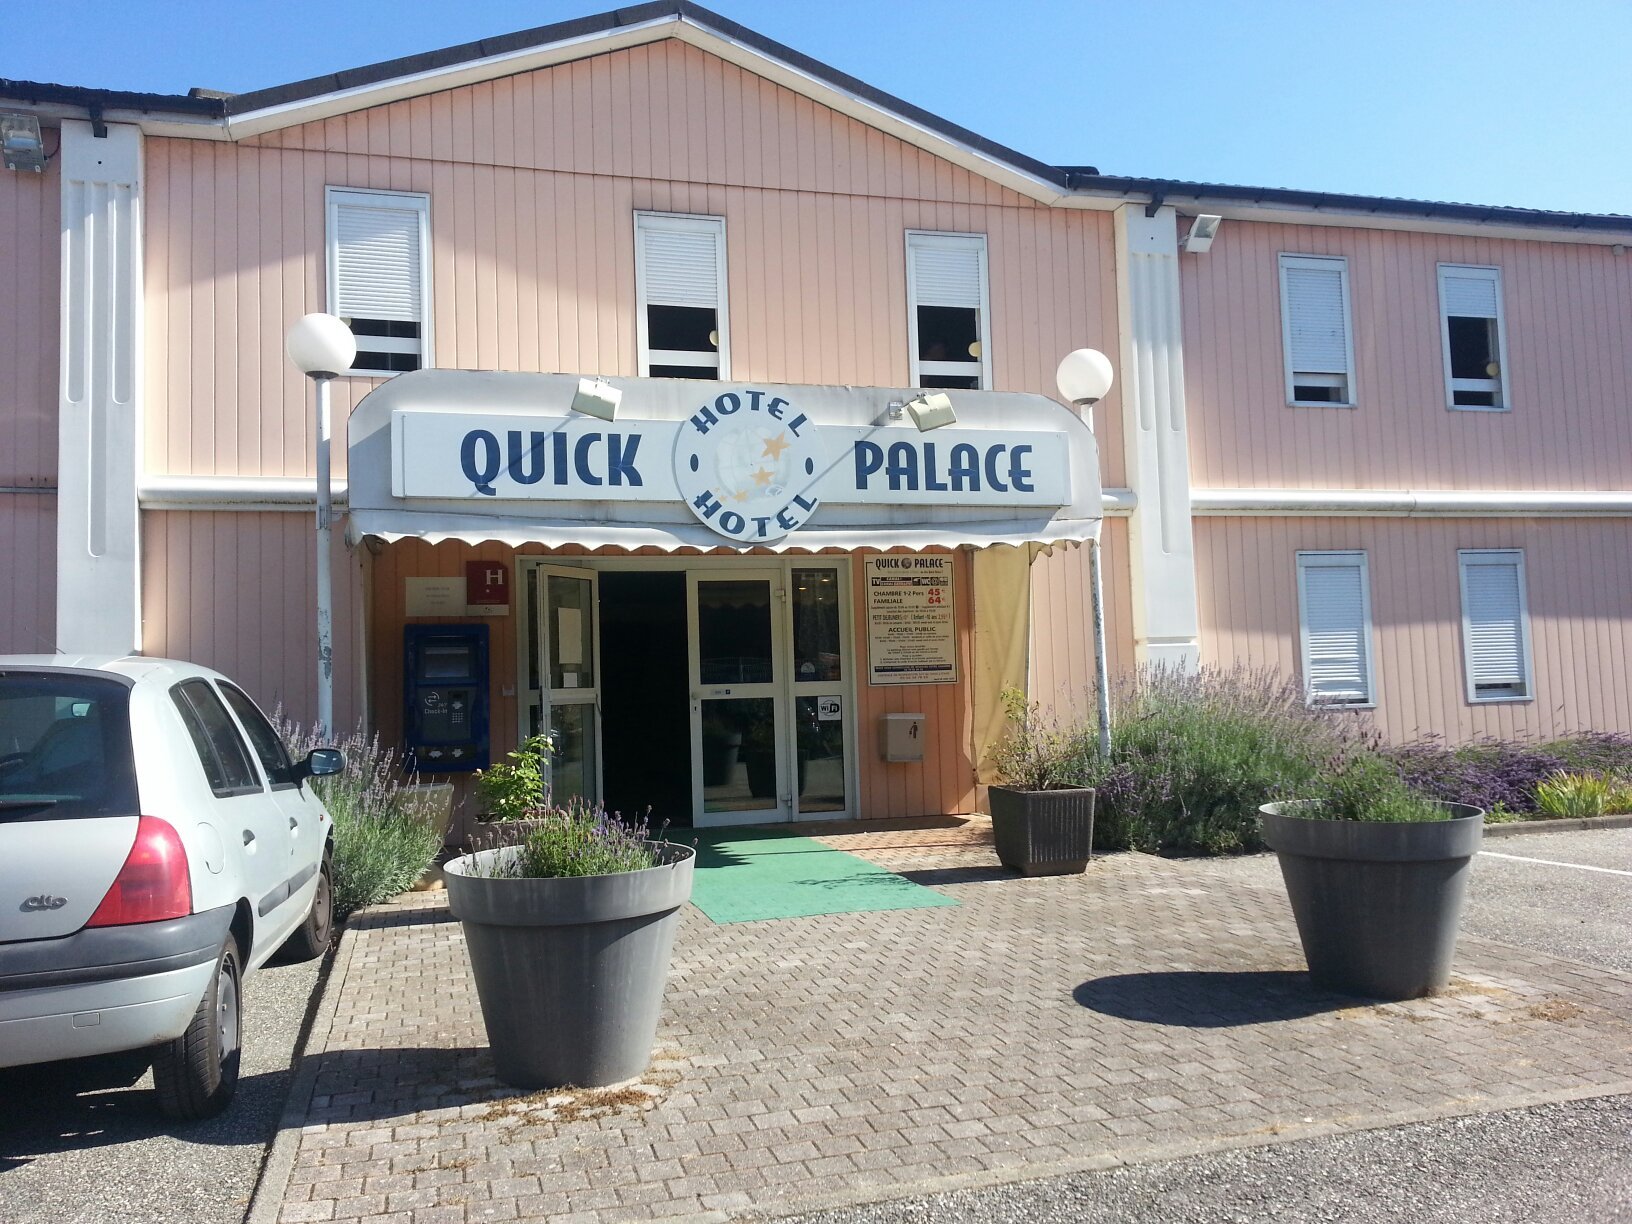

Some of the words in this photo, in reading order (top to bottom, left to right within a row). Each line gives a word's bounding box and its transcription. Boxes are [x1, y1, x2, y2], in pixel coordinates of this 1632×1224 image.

[690, 390, 808, 437] HOTEL
[460, 429, 643, 495] QUICK
[855, 440, 1035, 493] PALACE
[693, 490, 818, 537] HOTEL
[486, 569, 503, 585] H
[875, 558, 900, 570] QUICK
[914, 558, 944, 568] PALACE
